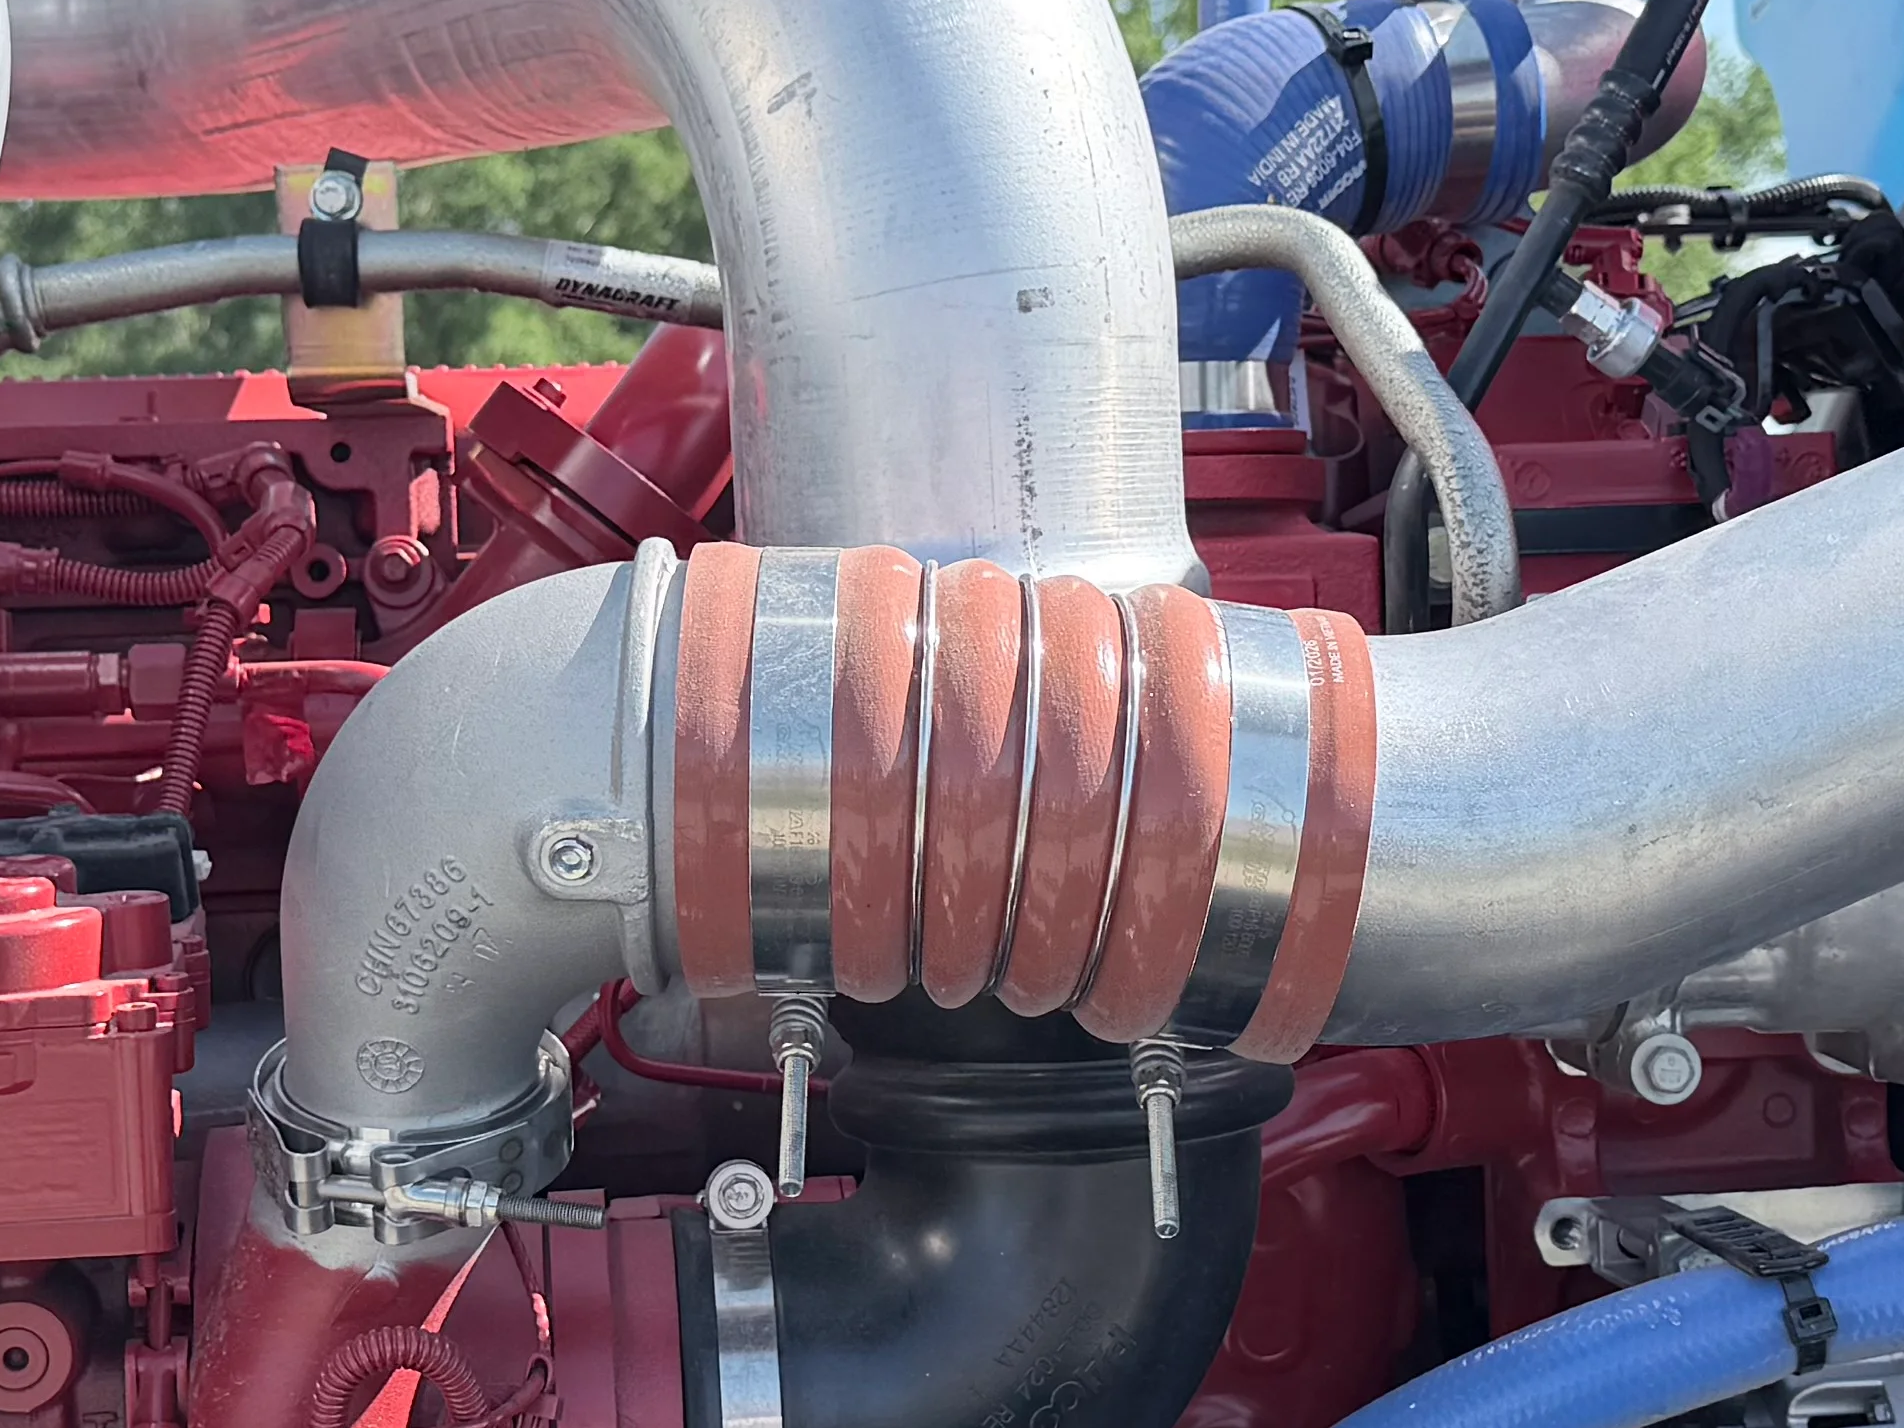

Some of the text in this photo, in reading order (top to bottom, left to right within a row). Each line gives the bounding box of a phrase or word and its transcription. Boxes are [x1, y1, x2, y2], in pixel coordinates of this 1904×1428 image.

[1245, 93, 1338, 189] MADE IN INDIA
